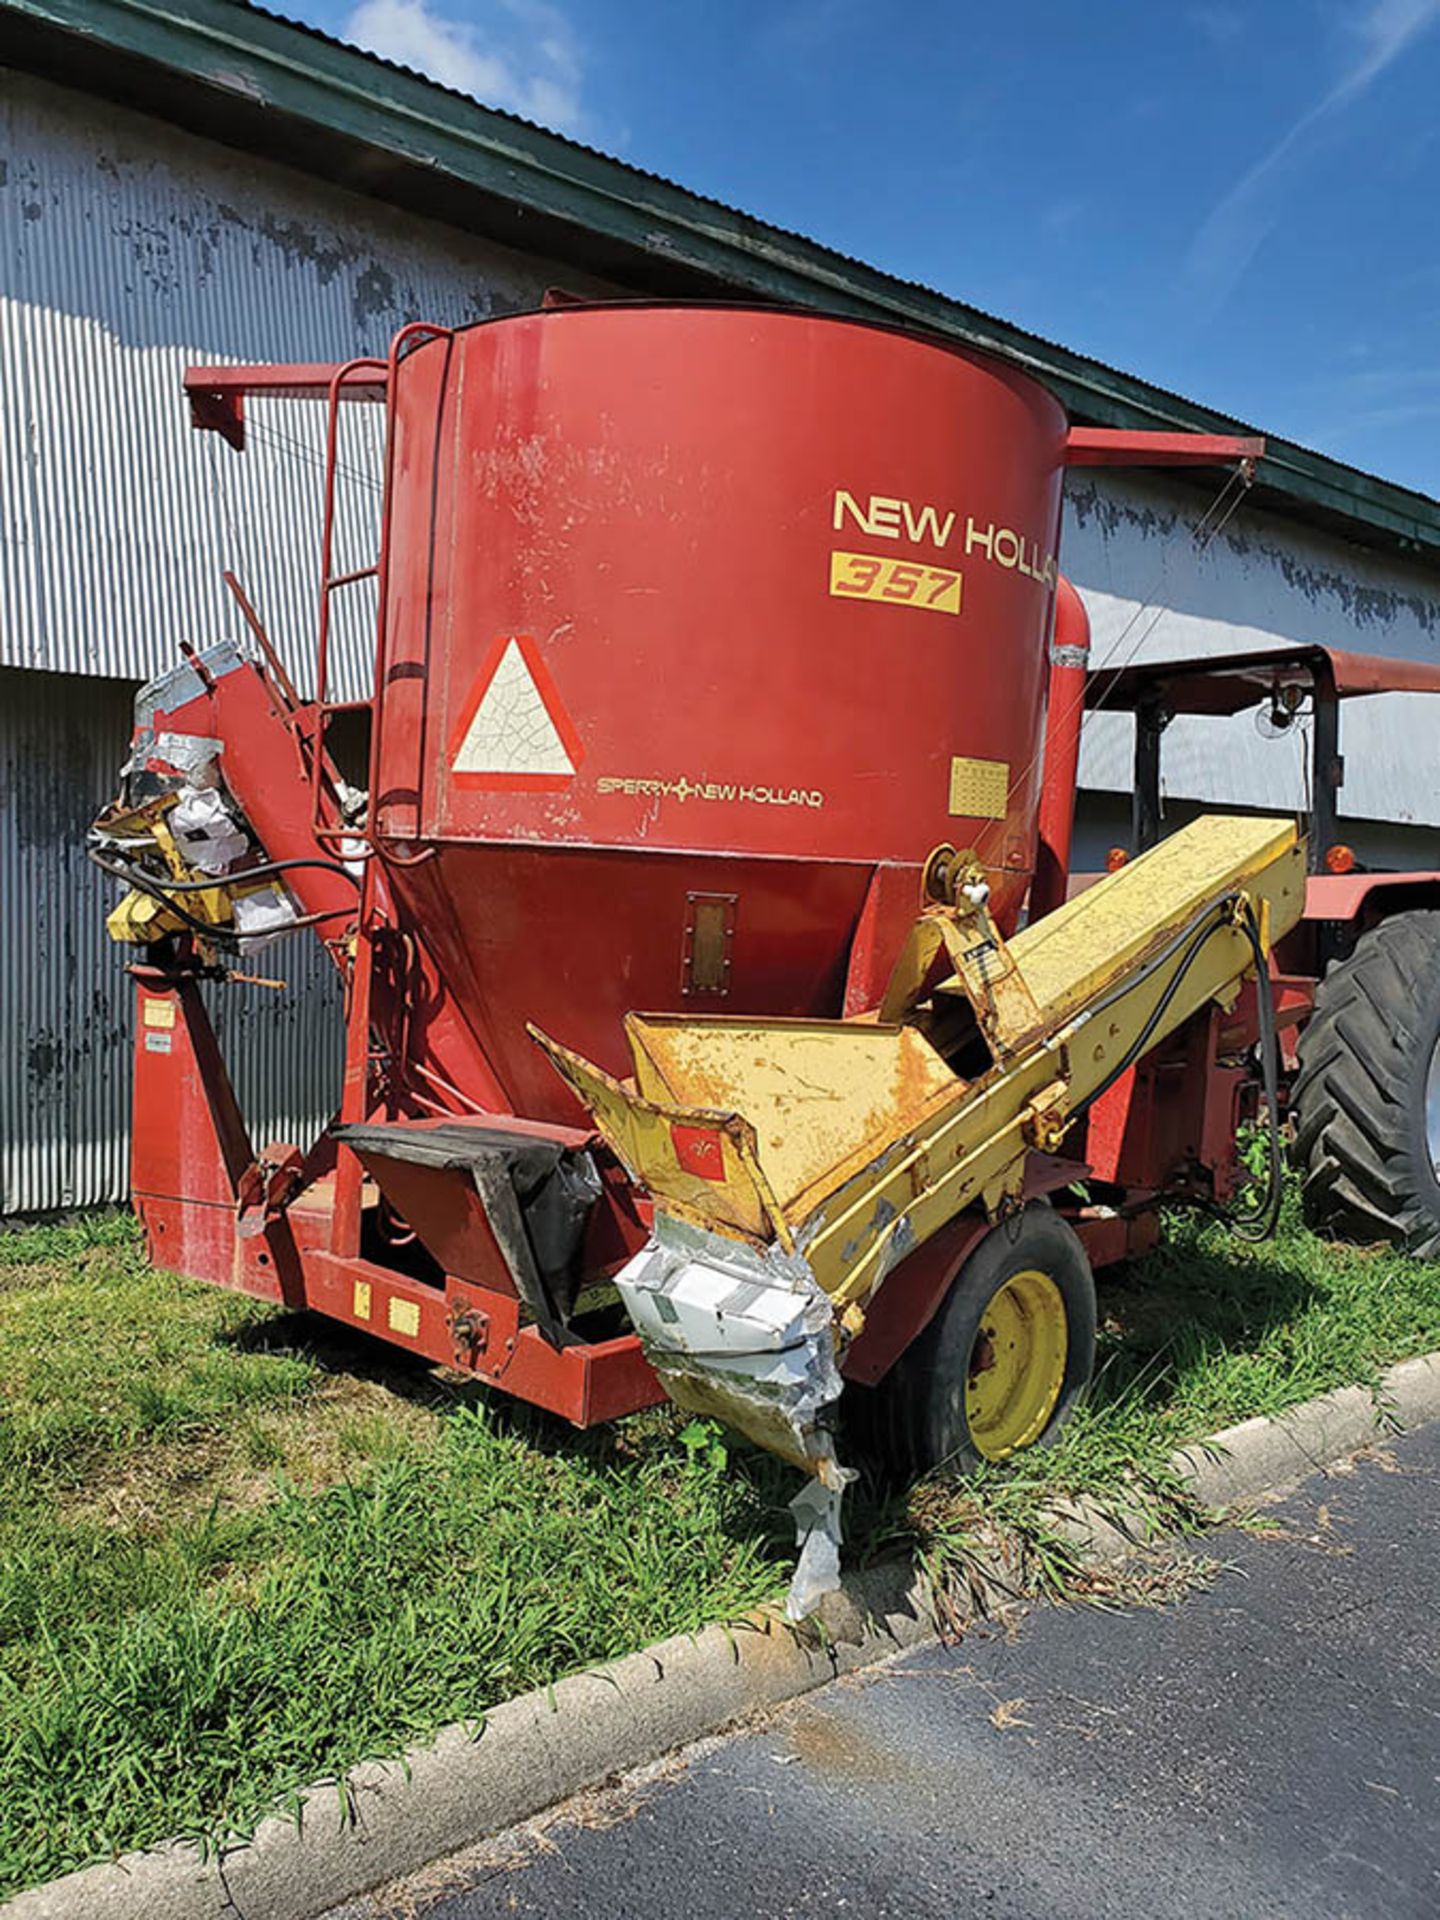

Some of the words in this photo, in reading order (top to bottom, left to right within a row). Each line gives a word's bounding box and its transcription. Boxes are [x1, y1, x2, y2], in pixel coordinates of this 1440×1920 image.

[833, 490, 956, 548] NEW
[964, 517, 1058, 593] HOLLA
[835, 558, 957, 605] 357
[597, 777, 672, 797] SPERRY
[694, 784, 737, 801] NEW
[739, 785, 824, 809] HOLLAND
